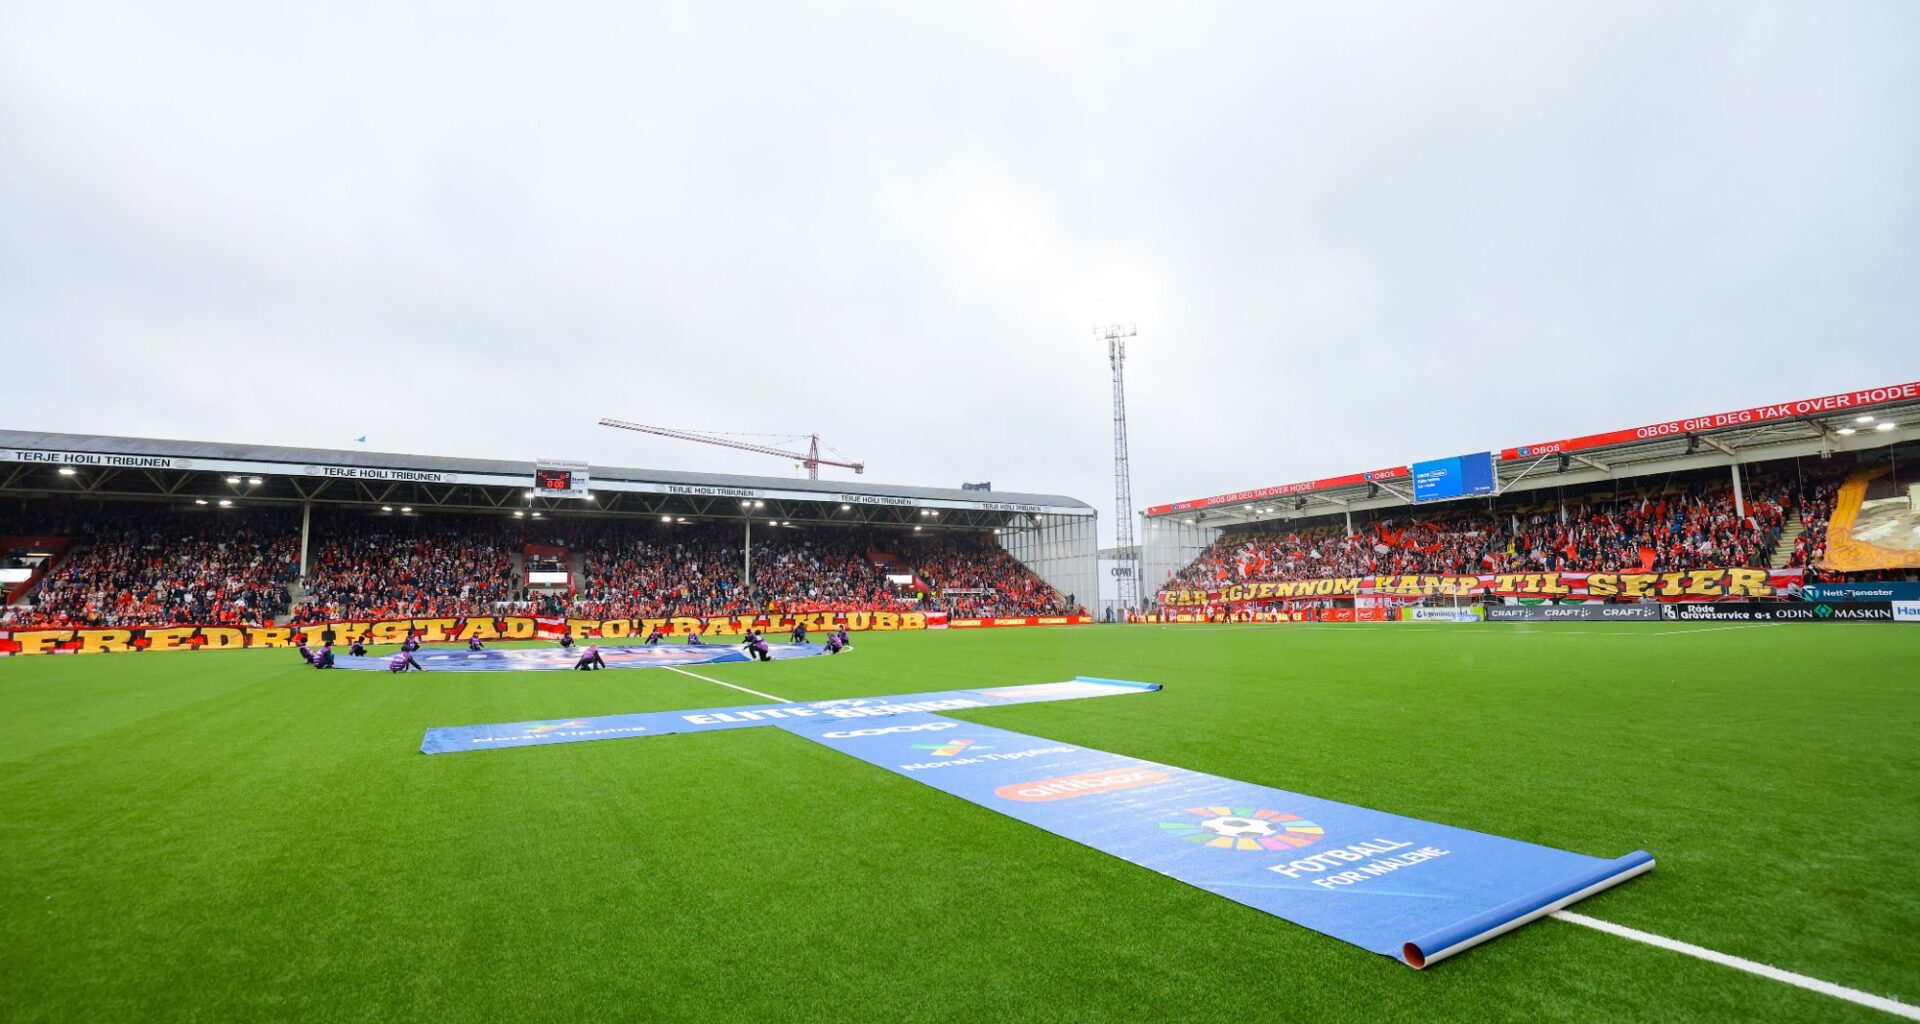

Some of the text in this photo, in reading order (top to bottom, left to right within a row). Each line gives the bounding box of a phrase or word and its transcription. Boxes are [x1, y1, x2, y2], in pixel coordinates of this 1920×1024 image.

[1636, 423, 1679, 439] OBOS
[1683, 418, 1711, 431] GIR
[1715, 411, 1751, 426] DEG
[1756, 403, 1792, 420] TAK
[1796, 394, 1851, 413] OVER
[1532, 443, 1560, 455] OBOS
[15, 451, 171, 468] TERJE HØILI TRIBUNEN
[323, 467, 441, 482] TERJE HØILI TRIBUNEN
[1374, 470, 1395, 480] OBOS
[669, 485, 693, 494] TERJE
[716, 488, 754, 497] TRIBUNEN
[1255, 489, 1268, 498] TAK
[1268, 486, 1289, 496] OVER
[1289, 481, 1316, 493] HODET
[1218, 577, 1362, 604] IGJENNOM
[1374, 575, 1479, 596] KAMP
[1495, 571, 1570, 595] TIL
[1586, 568, 1774, 597] SEIER
[1603, 608, 1643, 617] CRAFT
[1775, 609, 1891, 618] ODIN MASKIN
[12, 617, 536, 656] FREDRIKSTAD
[682, 705, 819, 726] ELITE
[472, 732, 550, 744] Norsk
[821, 721, 958, 740] coop
[899, 753, 982, 773] Norsk
[1016, 770, 1157, 799] altibox
[1267, 837, 1415, 879] FOTBALL
[1311, 871, 1372, 890] FOR
